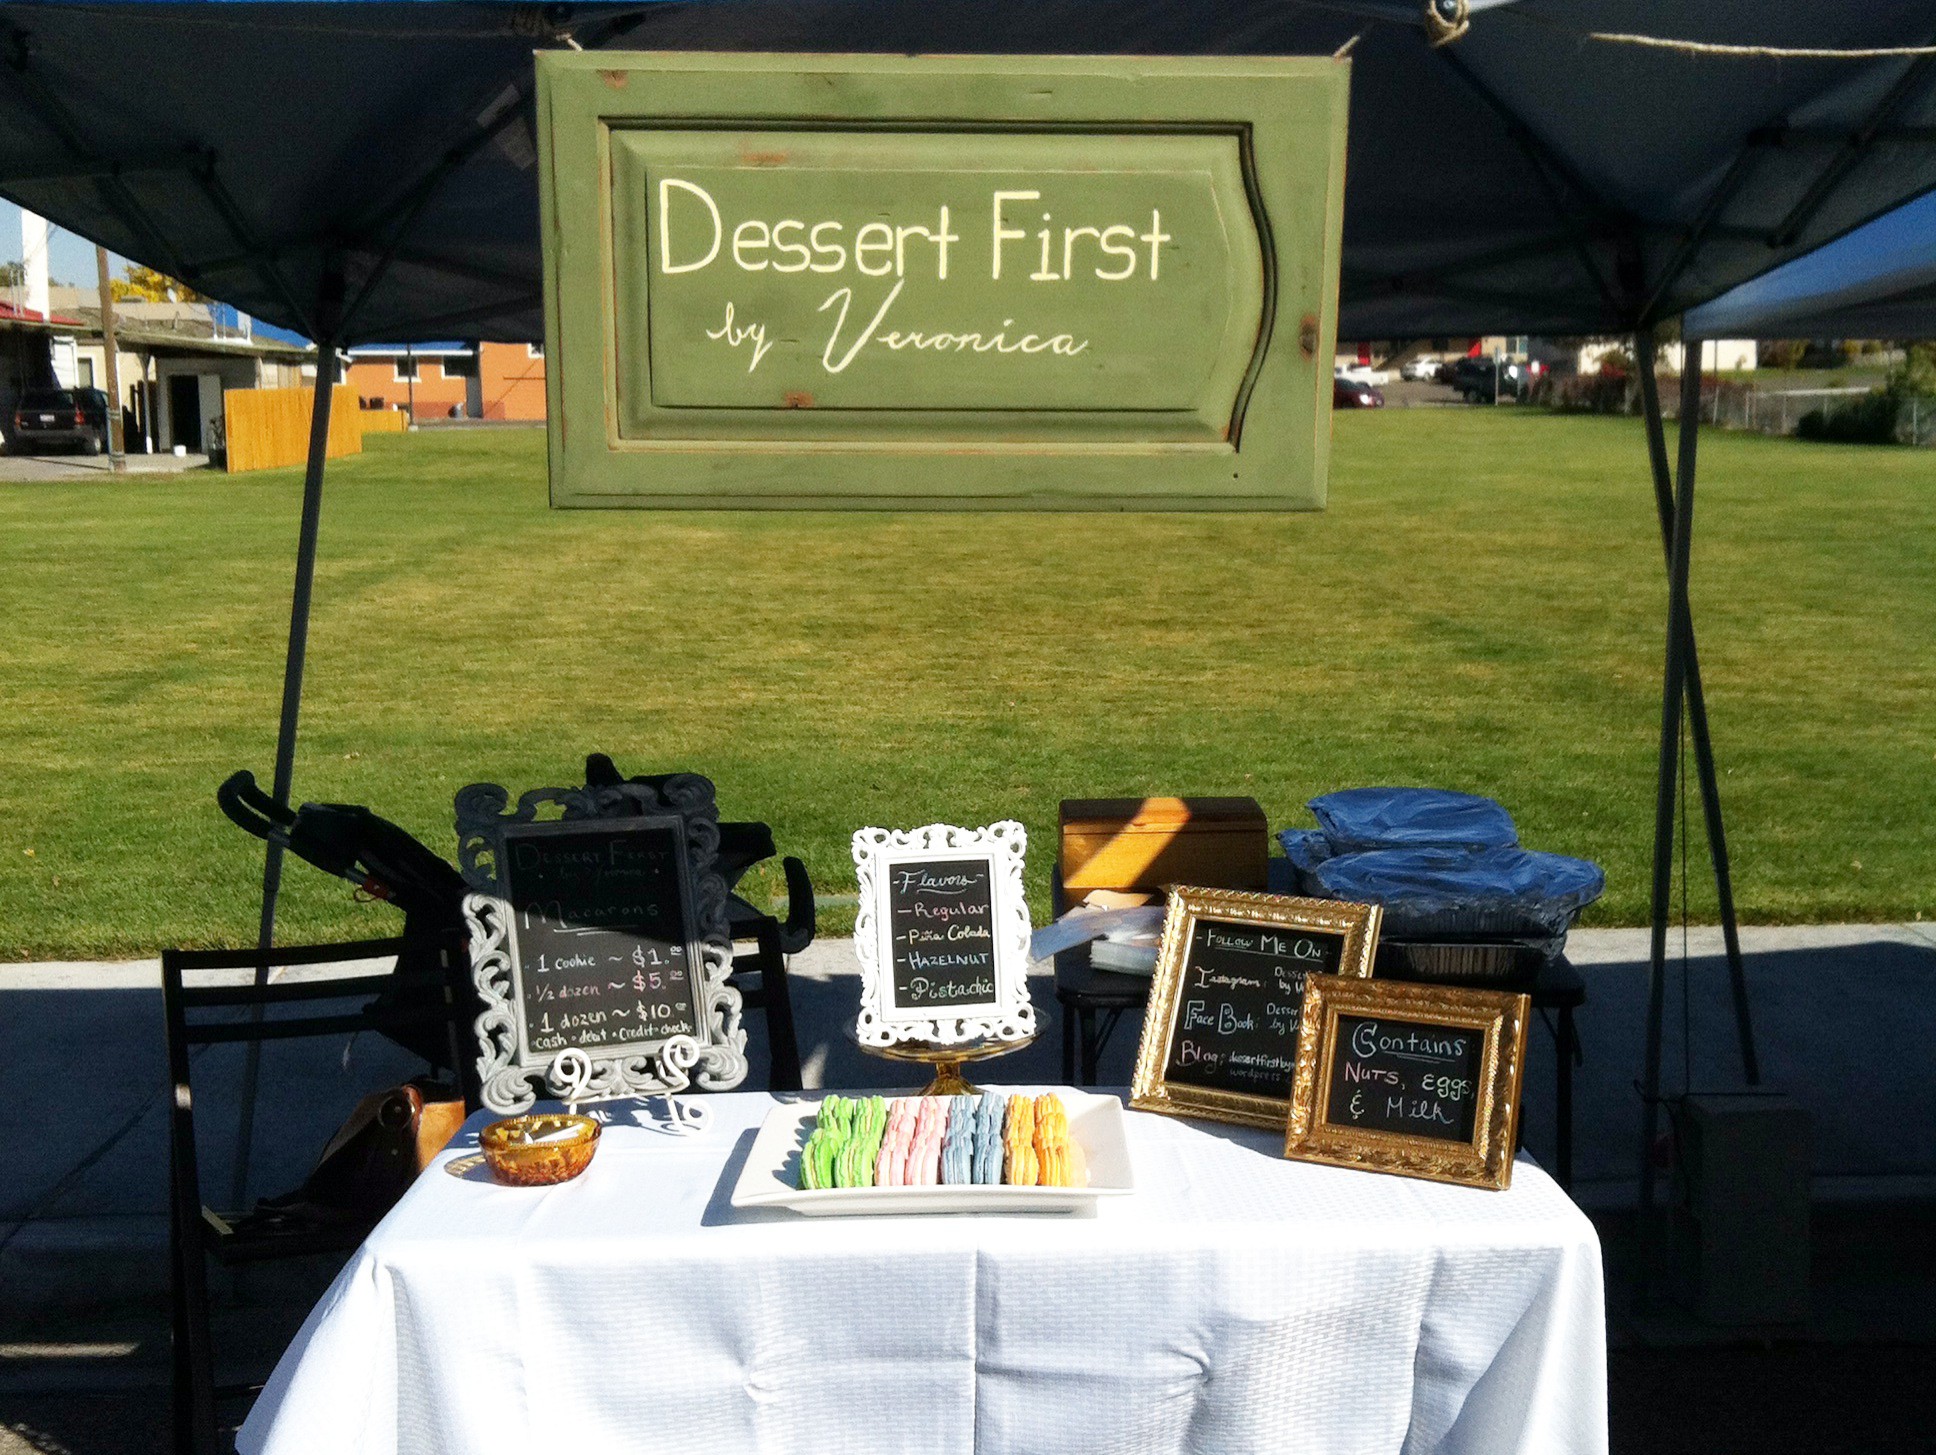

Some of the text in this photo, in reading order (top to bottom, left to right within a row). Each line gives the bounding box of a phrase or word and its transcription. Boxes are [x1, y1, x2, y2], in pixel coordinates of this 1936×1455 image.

[658, 177, 1172, 281] Dessert First
[705, 278, 1093, 375] by Veronica
[524, 899, 660, 930] Macarons
[914, 901, 989, 922] Regular
[947, 924, 991, 942] Colada
[537, 954, 550, 973] 1
[908, 950, 990, 971] HAZELNUT
[559, 984, 601, 999] dozen
[540, 1011, 554, 1033] 1
[560, 1010, 608, 1030] dozen
[1352, 1021, 1467, 1058] Contains
